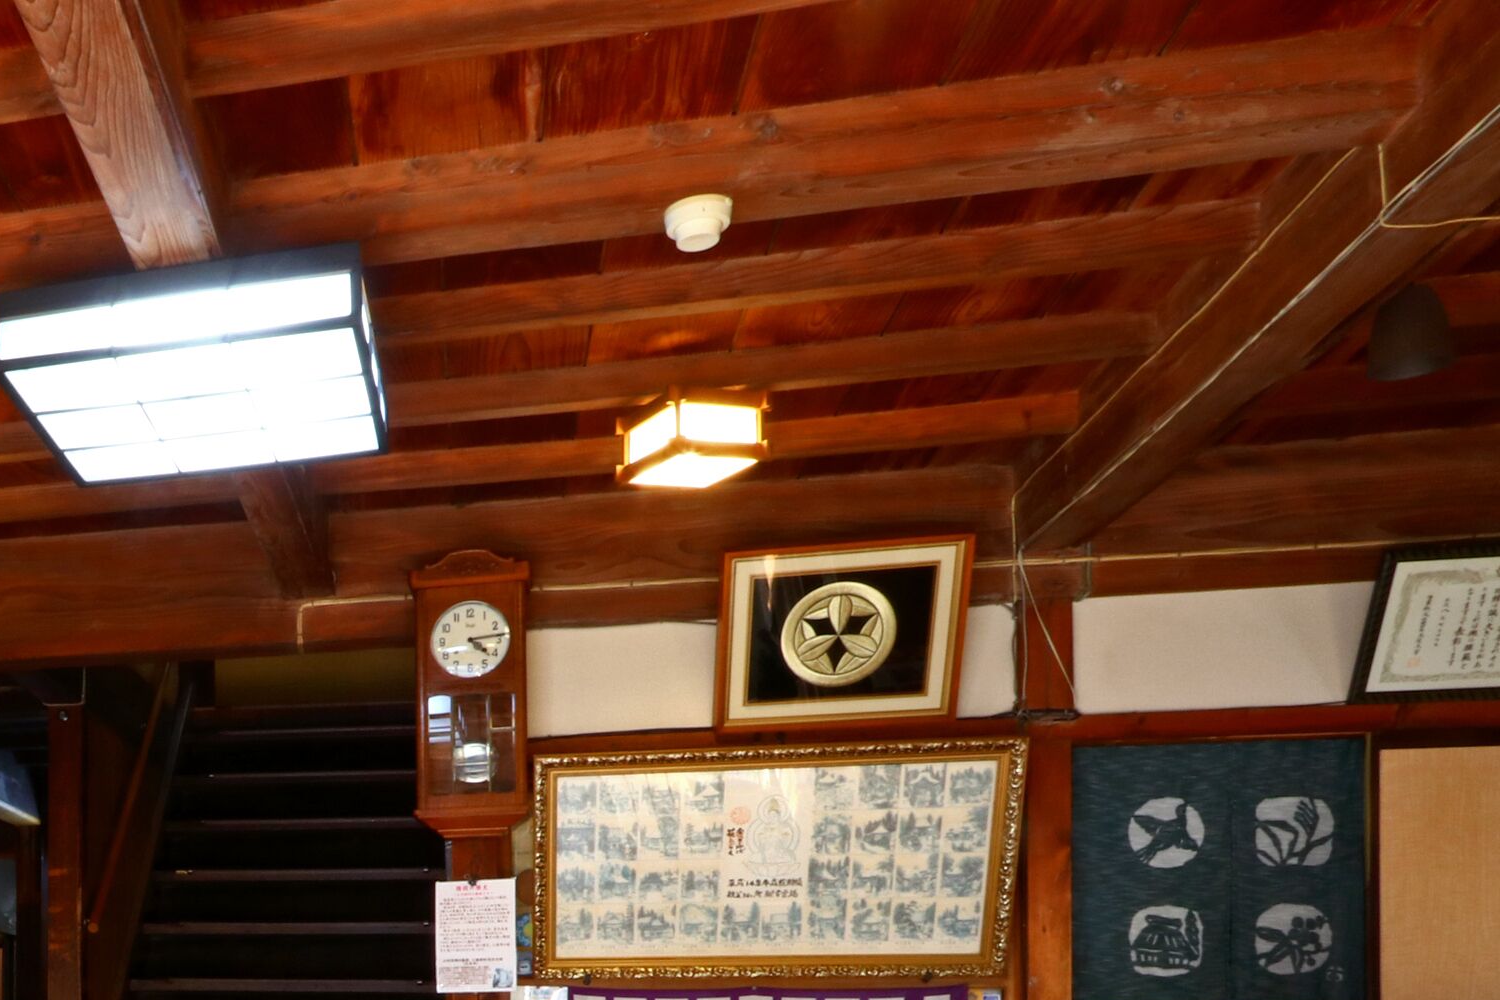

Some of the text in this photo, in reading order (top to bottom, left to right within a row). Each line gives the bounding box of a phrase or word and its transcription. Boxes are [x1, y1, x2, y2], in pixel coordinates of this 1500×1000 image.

[453, 613, 460, 622] 11
[466, 608, 475, 618] 12
[442, 623, 451, 633] 10
[491, 621, 499, 630] 2
[439, 638, 446, 647] 9
[442, 651, 449, 660] 8
[491, 648, 498, 657] 4
[467, 664, 474, 673] 6
[482, 659, 488, 669] 5
